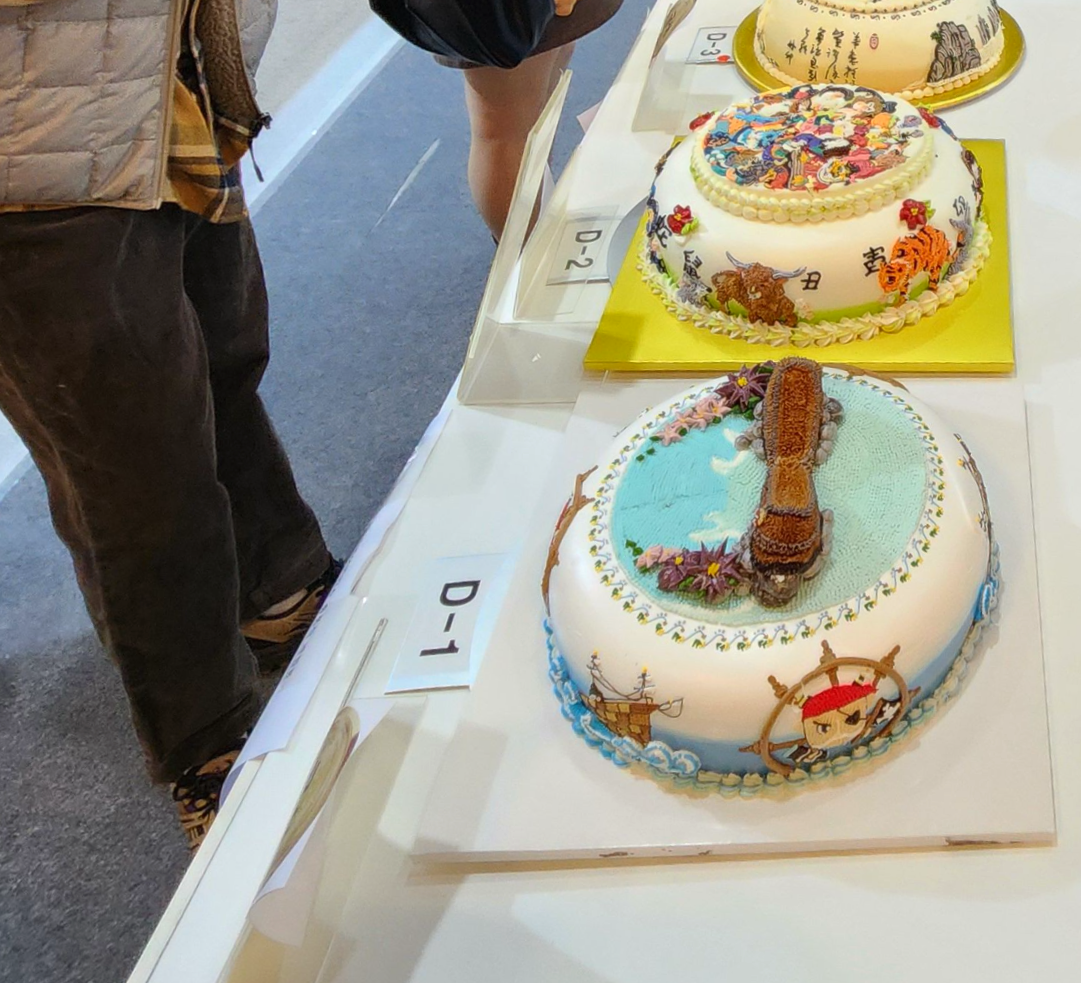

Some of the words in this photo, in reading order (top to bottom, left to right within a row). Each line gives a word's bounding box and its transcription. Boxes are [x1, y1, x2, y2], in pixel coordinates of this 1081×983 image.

[701, 32, 727, 56] D-3
[565, 230, 603, 270] D-2
[420, 580, 481, 657] D-1
